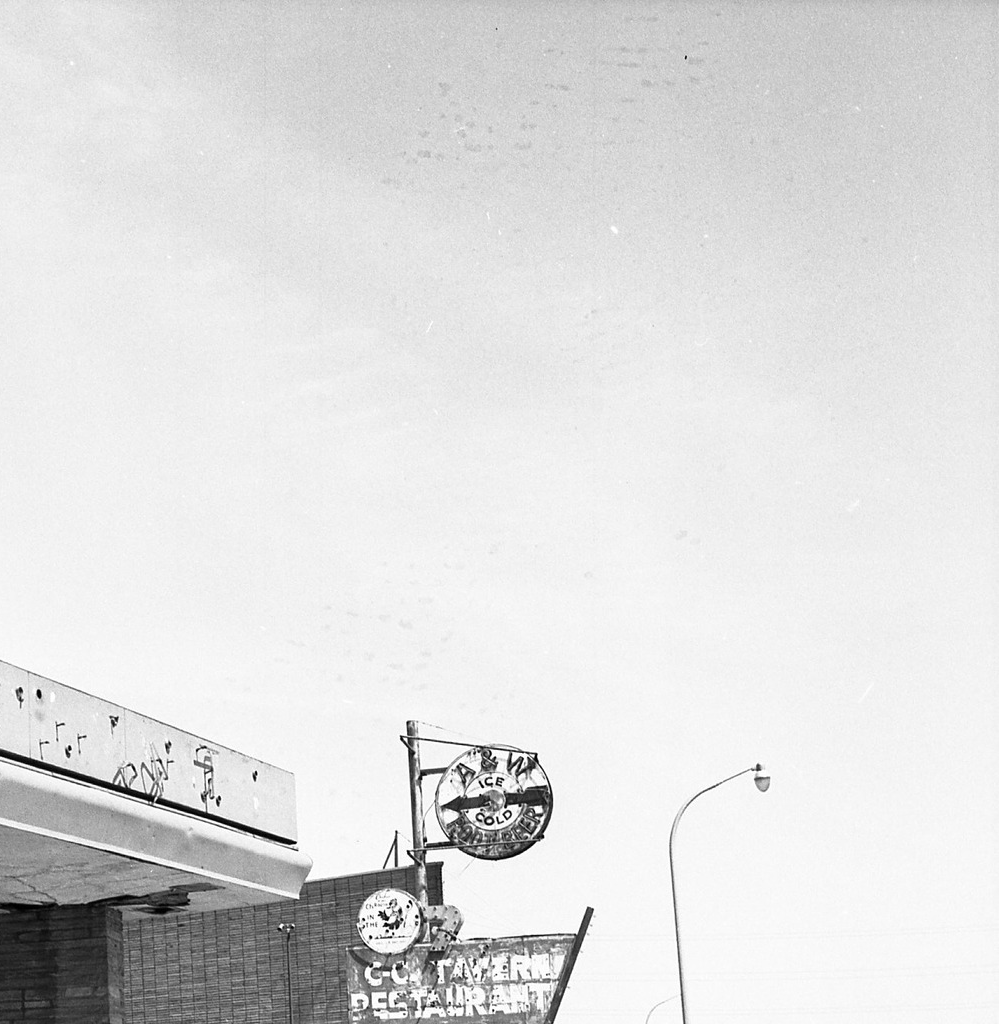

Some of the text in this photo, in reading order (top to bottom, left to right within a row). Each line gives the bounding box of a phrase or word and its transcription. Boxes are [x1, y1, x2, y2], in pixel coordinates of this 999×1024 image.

[456, 763, 476, 788] A
[478, 776, 505, 789] ICE
[475, 809, 513, 826] COLD
